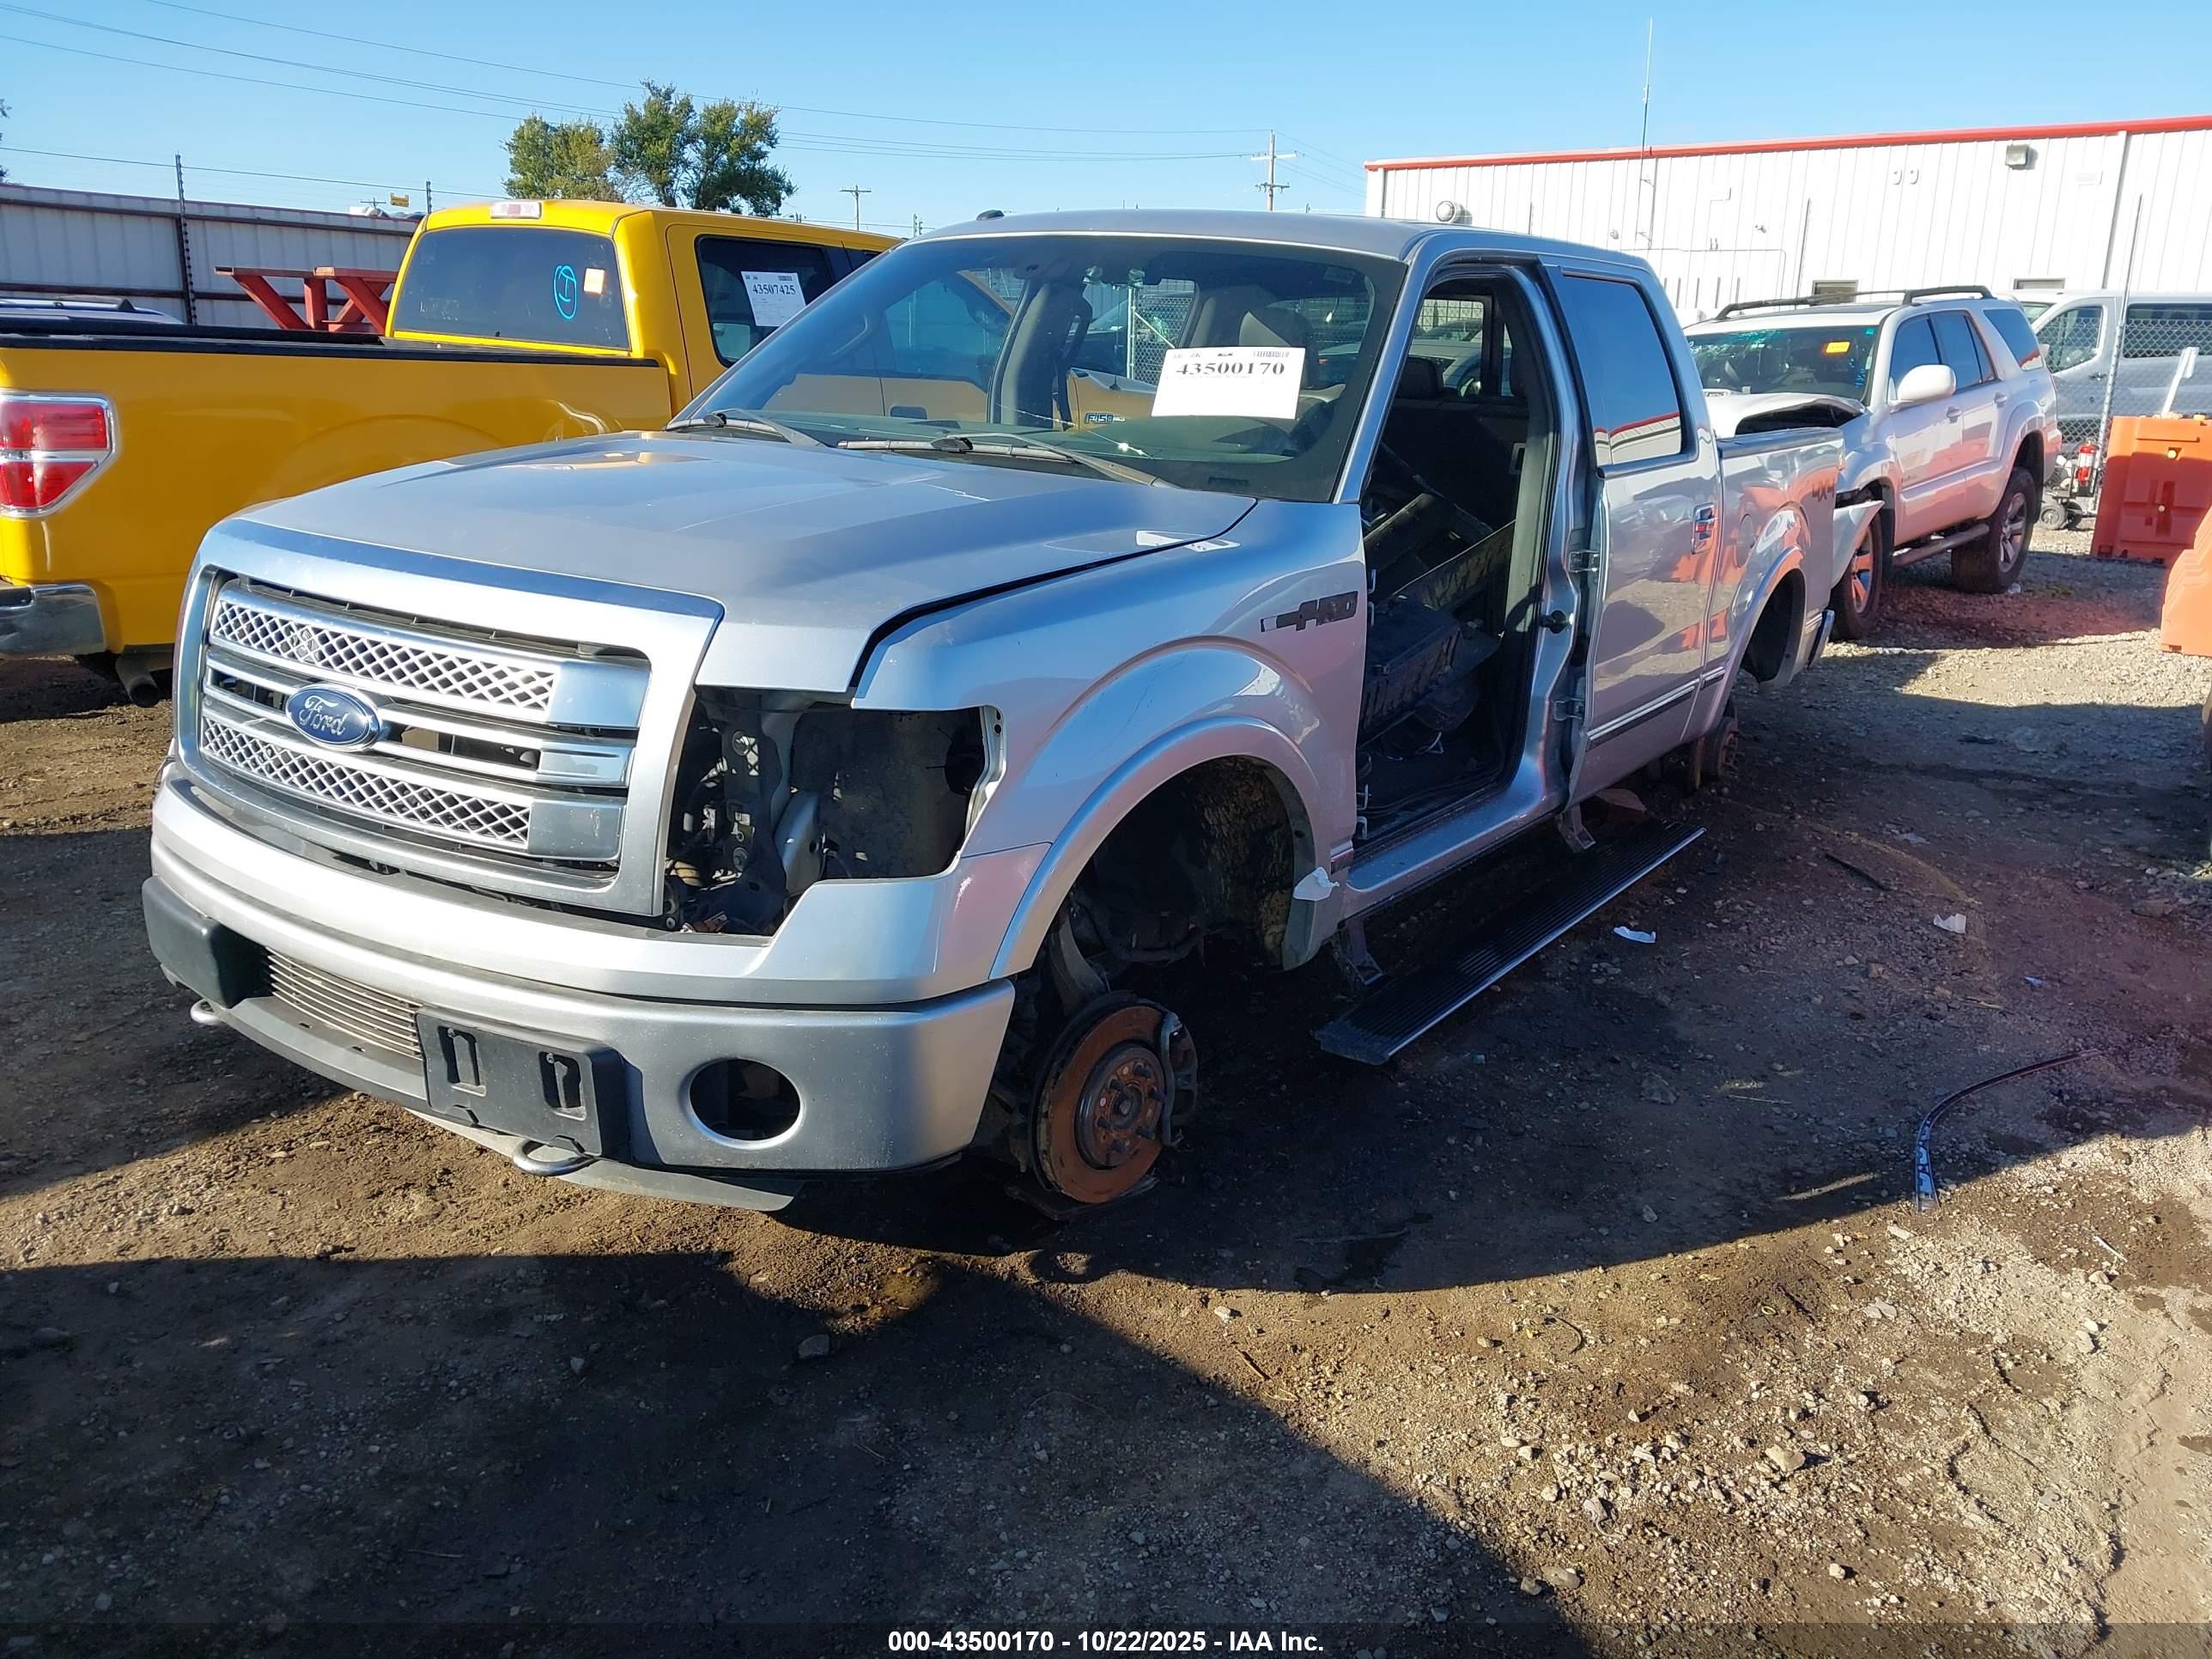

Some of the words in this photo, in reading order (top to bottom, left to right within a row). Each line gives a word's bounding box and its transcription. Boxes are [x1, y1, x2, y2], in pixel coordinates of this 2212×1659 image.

[752, 283, 797, 295] 43507425
[1176, 362, 1285, 375] 43500170
[298, 696, 350, 736] Ford
